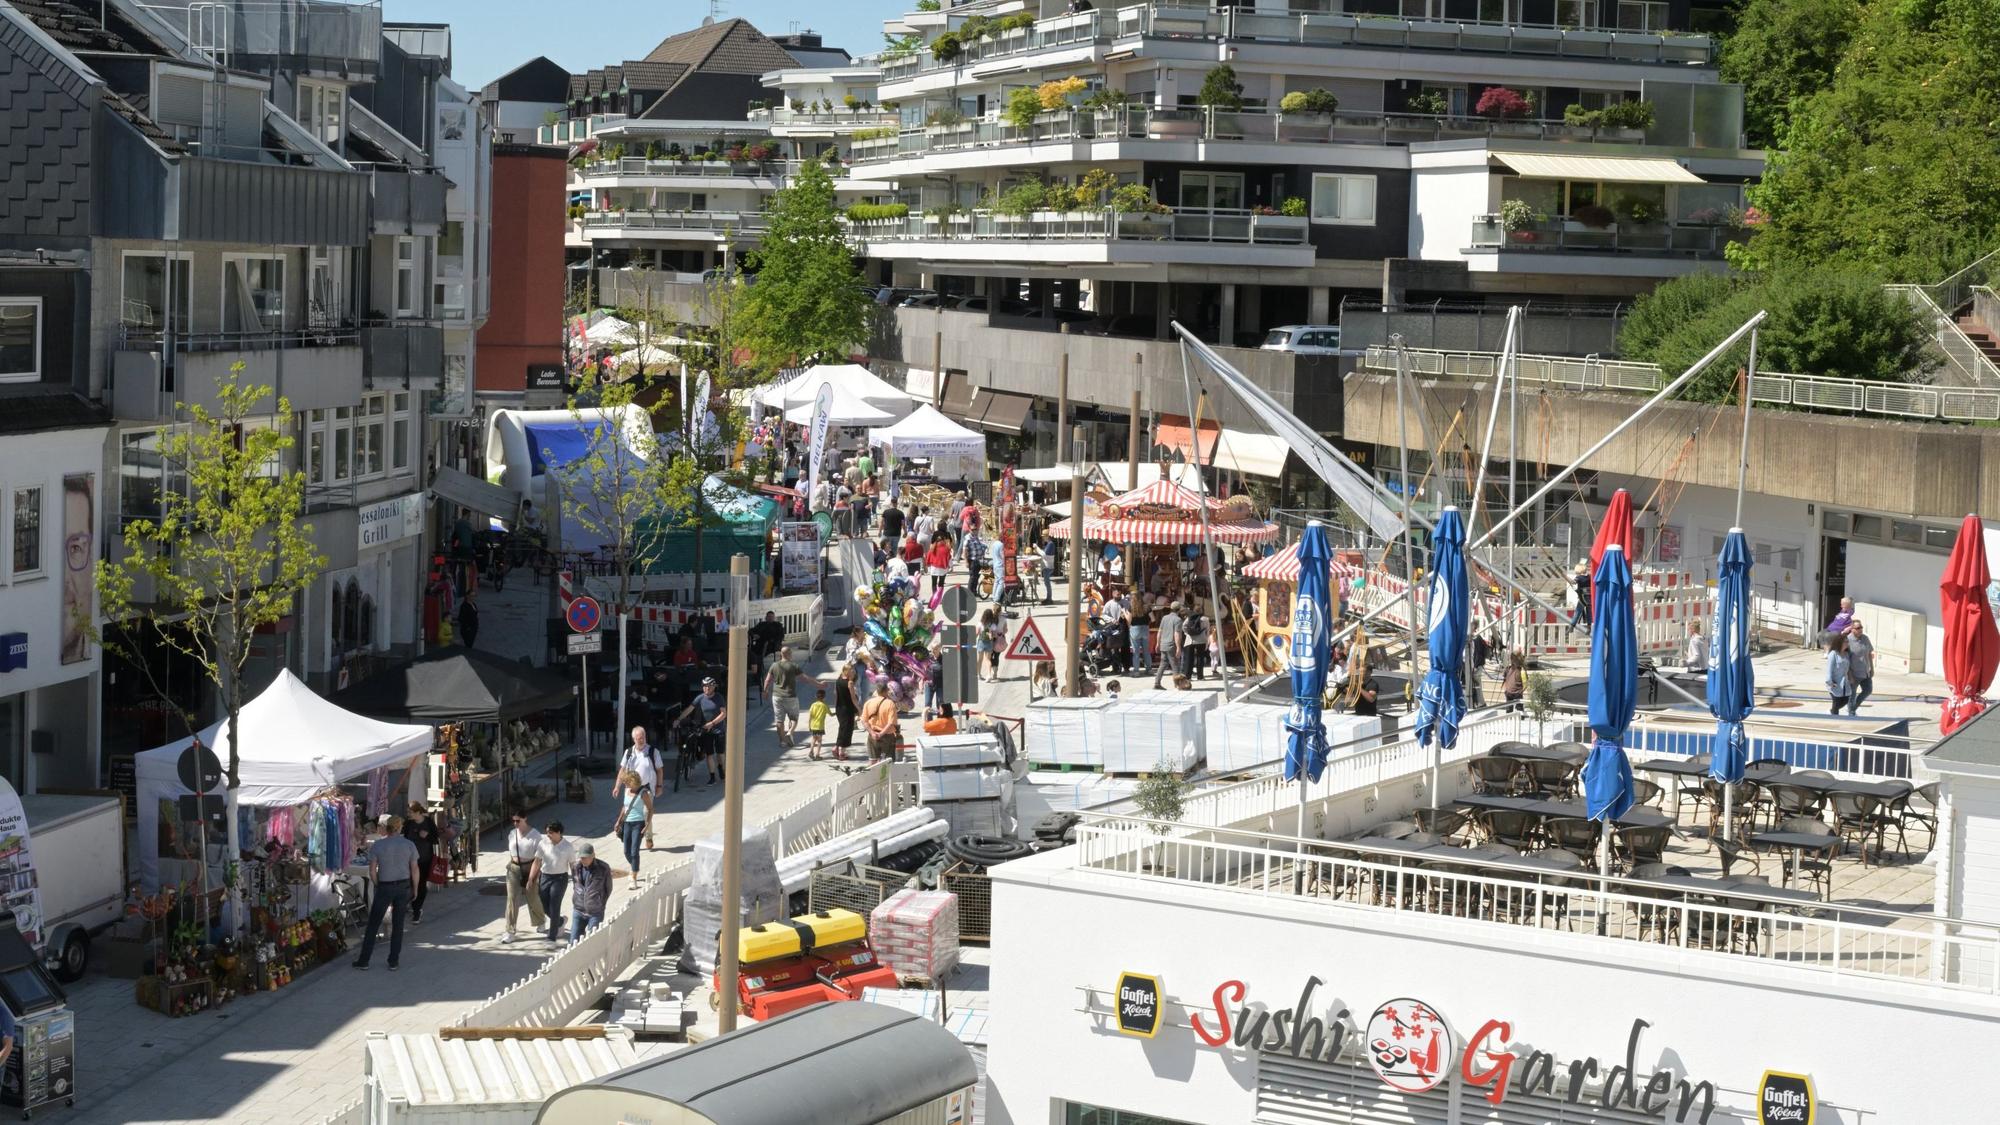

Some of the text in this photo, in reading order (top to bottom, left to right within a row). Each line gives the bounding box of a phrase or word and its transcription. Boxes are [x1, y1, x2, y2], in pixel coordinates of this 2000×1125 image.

[359, 501, 400, 525] essaloniki
[363, 524, 388, 545] Grill
[1190, 975, 1716, 1125] Sushi Garden
[1766, 1105, 1804, 1121] Kölsch
